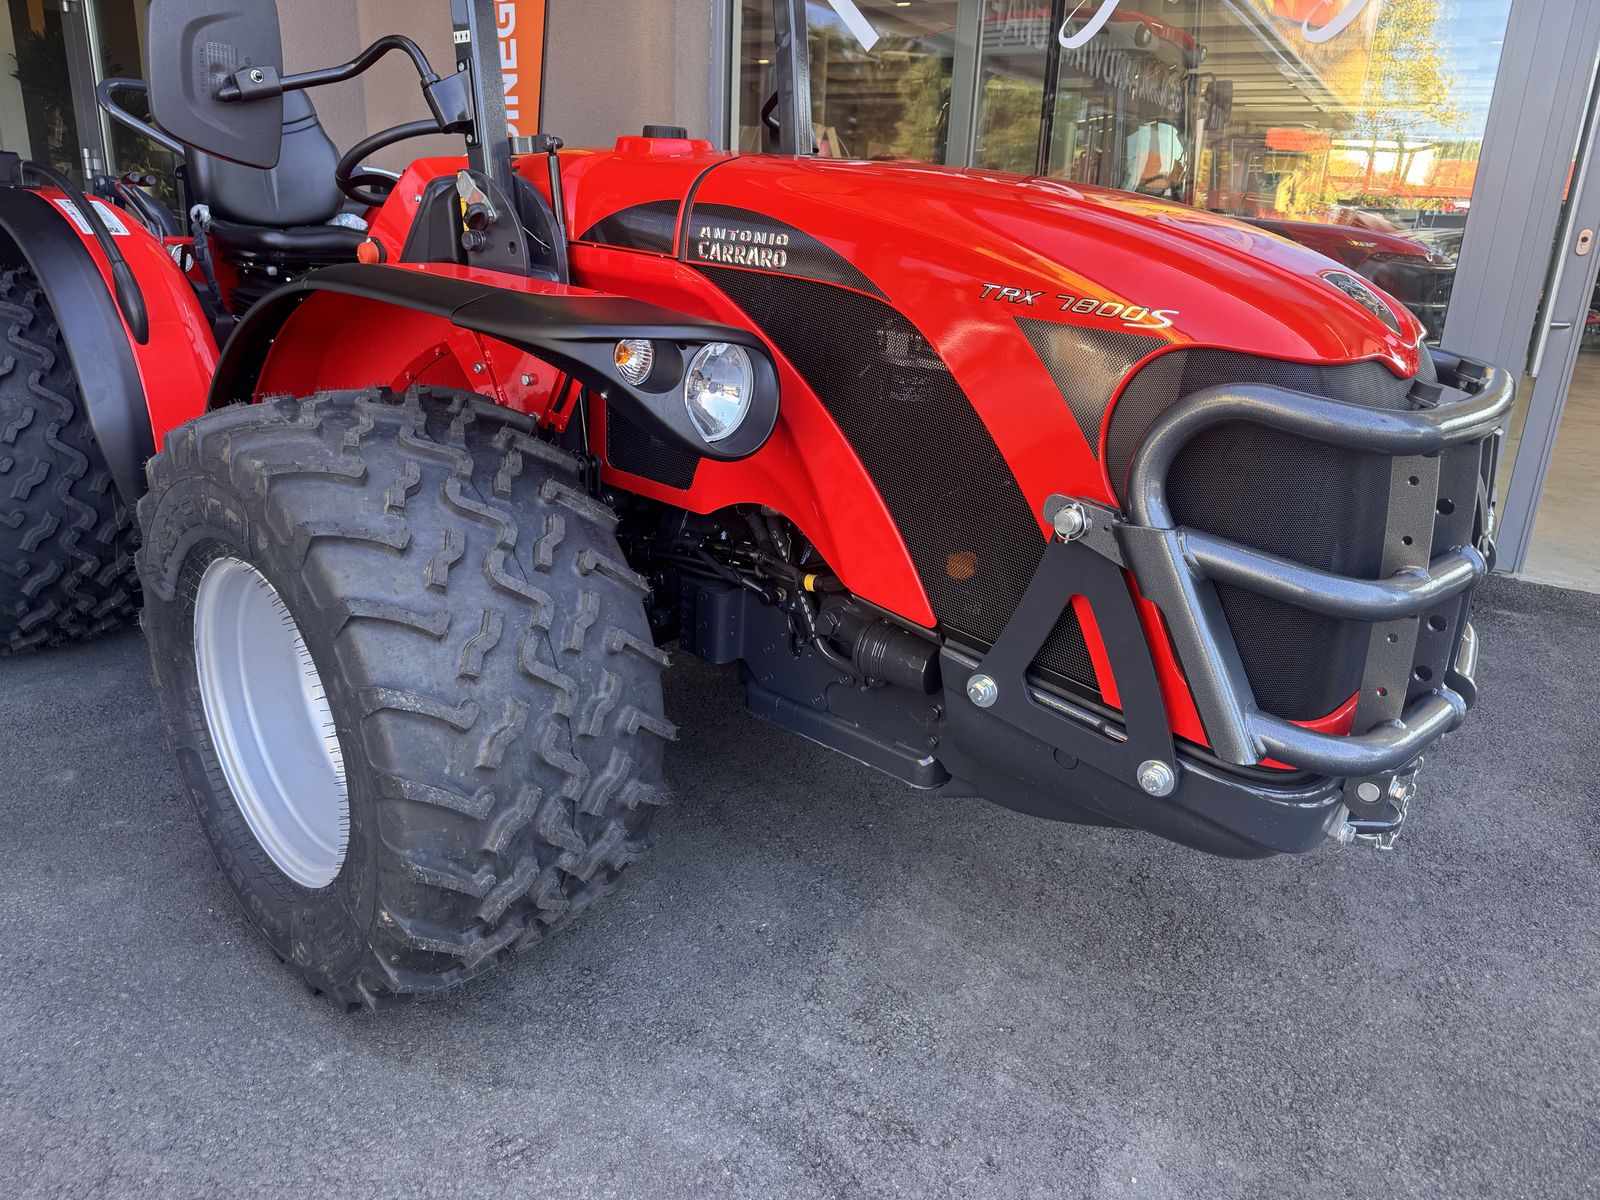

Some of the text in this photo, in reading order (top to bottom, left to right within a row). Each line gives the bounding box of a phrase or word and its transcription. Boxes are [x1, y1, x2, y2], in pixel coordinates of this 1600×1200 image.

[700, 226, 789, 246] ANTONIO
[698, 241, 788, 269] CARRARO
[979, 283, 1043, 306] TRX
